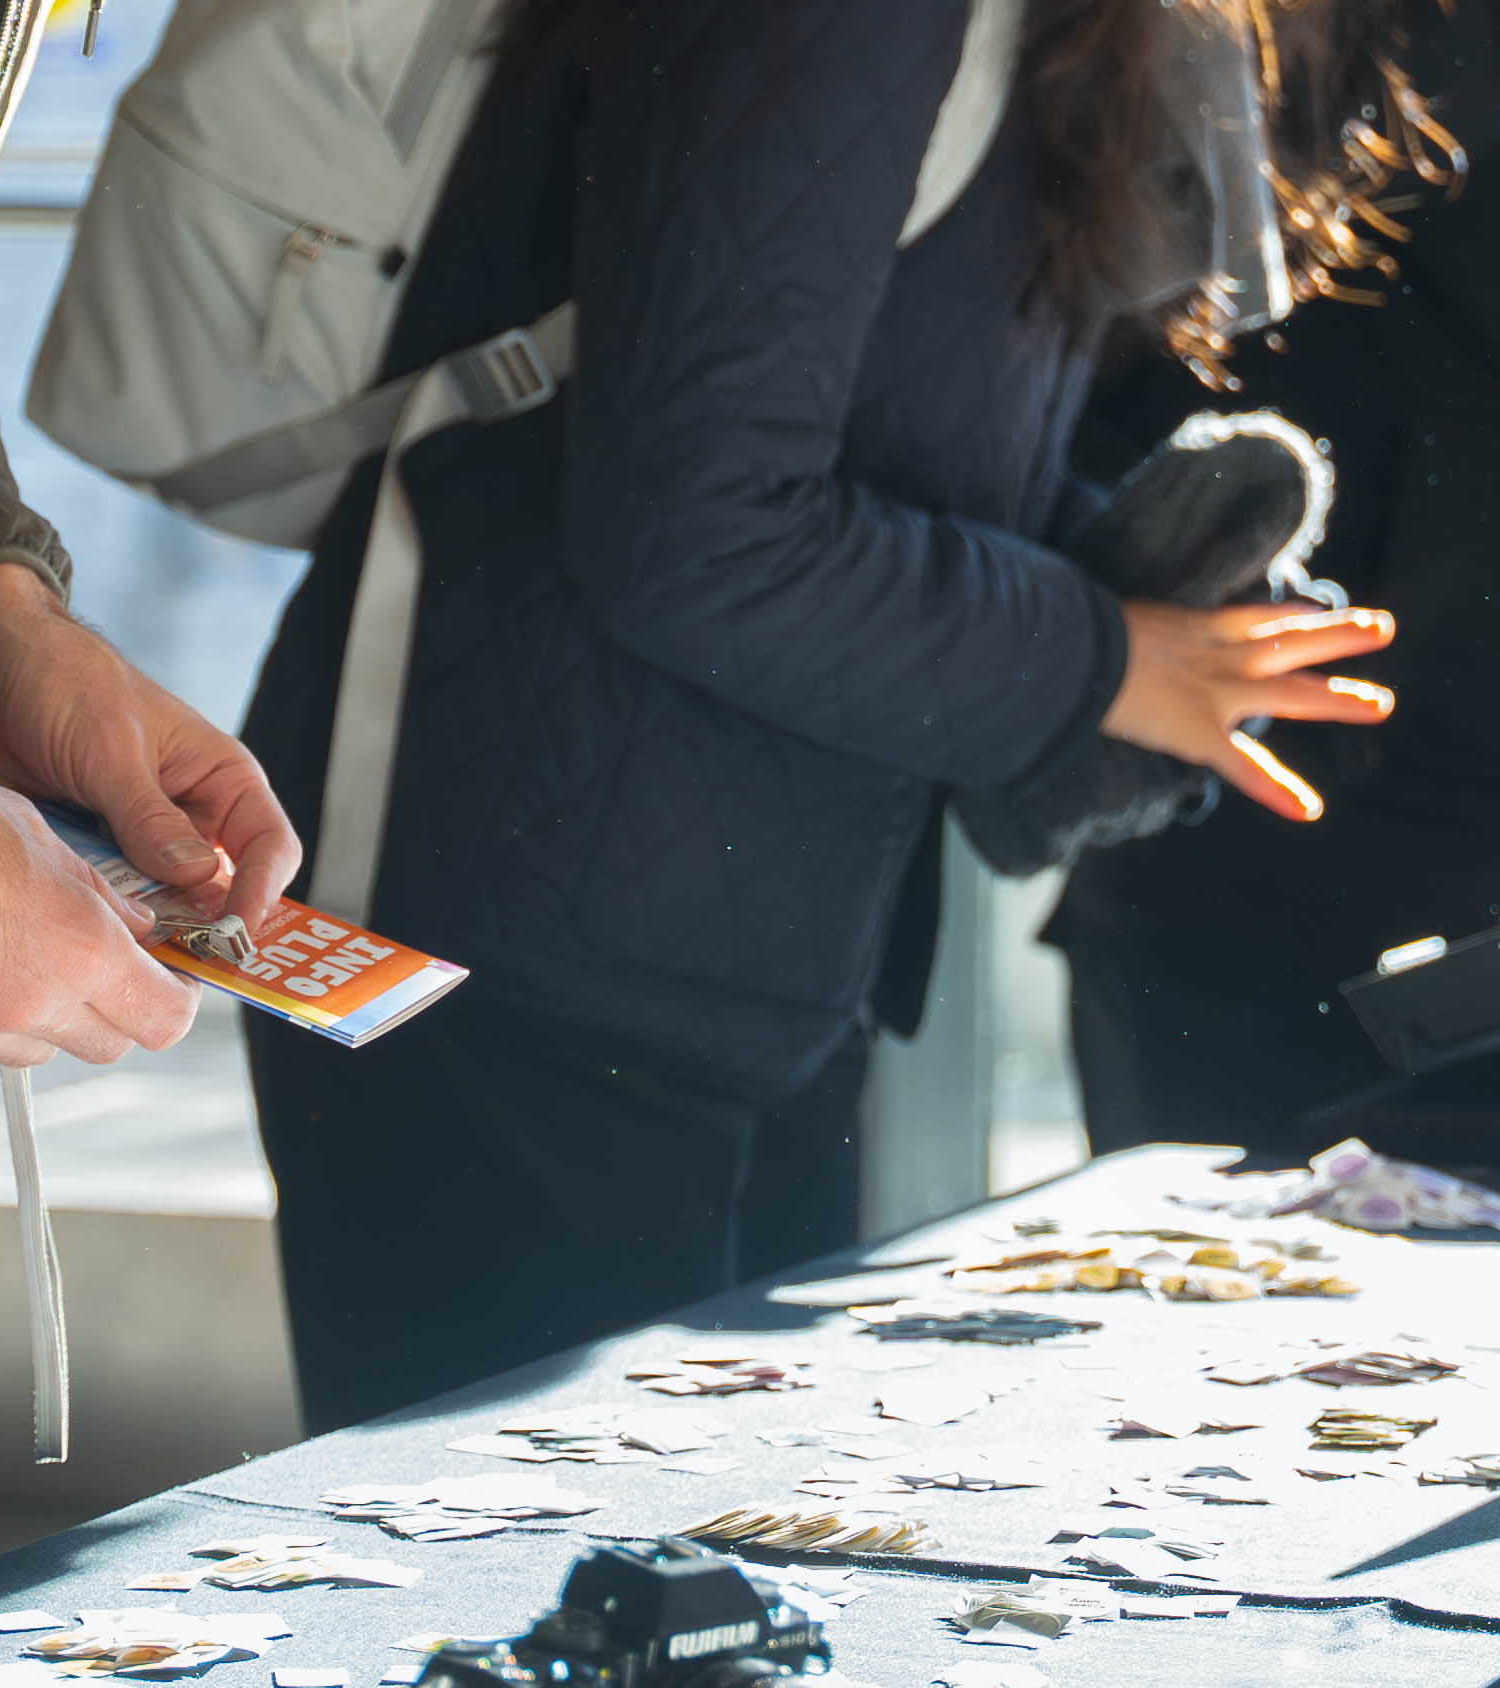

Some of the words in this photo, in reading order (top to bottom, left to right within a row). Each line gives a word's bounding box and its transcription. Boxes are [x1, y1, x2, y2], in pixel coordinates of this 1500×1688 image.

[239, 918, 350, 981] PLUS
[284, 936, 396, 996] INFO
[668, 1620, 760, 1660] FUJIFILM
